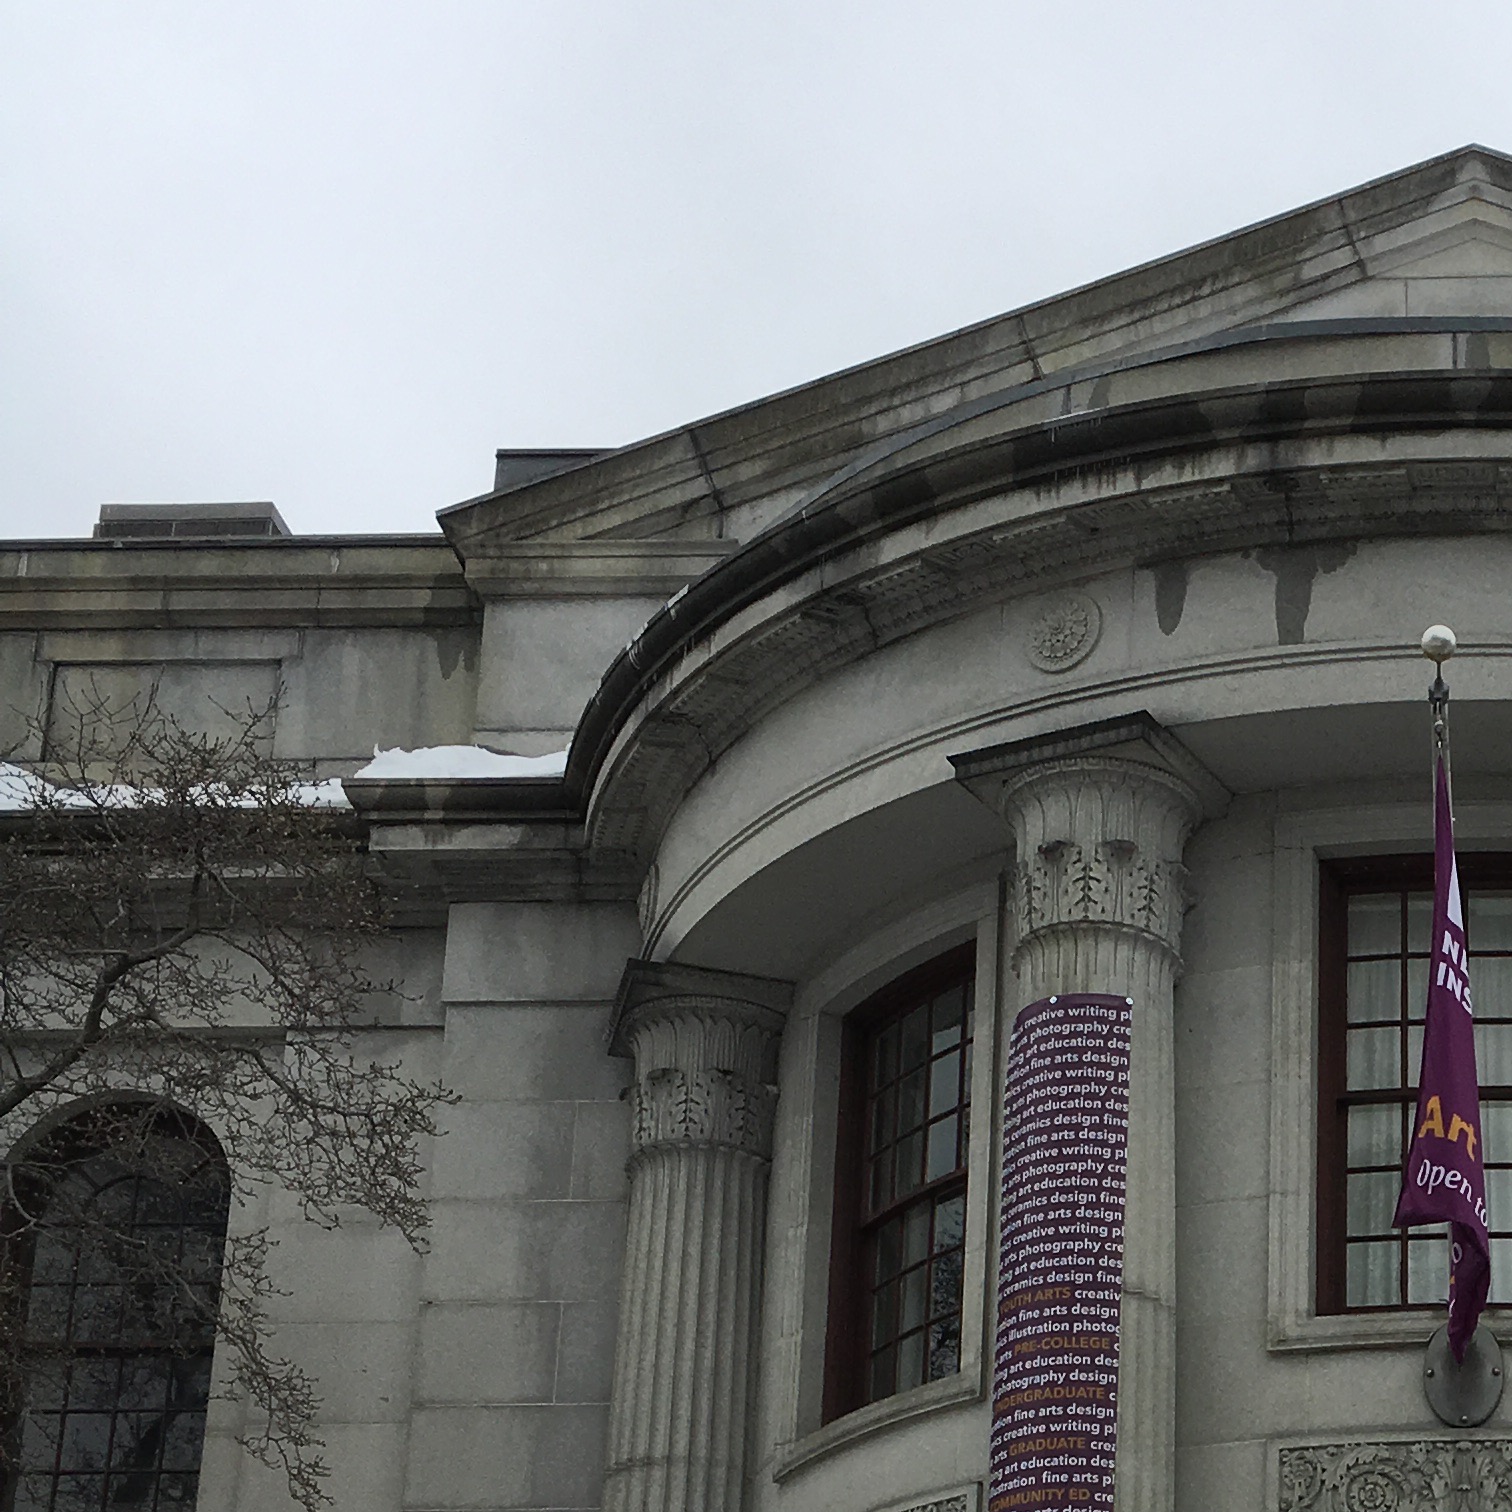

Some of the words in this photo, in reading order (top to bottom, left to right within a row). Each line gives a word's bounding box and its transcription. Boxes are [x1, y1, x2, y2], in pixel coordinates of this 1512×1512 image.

[1024, 1009, 1065, 1029] creative
[1068, 1006, 1116, 1020] writing
[1030, 1021, 1109, 1044] photography
[1040, 1036, 1104, 1051] education
[1031, 1058, 1051, 1069] fine
[1055, 1053, 1078, 1063] arts
[1082, 1051, 1127, 1066] design
[1022, 1070, 1062, 1089] creative
[1066, 1066, 1114, 1081] writing
[1027, 1082, 1107, 1104] photography
[1037, 1097, 1101, 1112] education
[1054, 1113, 1099, 1126] design
[1104, 1114, 1129, 1127] fine
[1027, 1135, 1048, 1146] fine
[1051, 1130, 1075, 1141] arts
[1079, 1128, 1124, 1144] design
[1017, 1148, 1058, 1166] creative
[1062, 1144, 1111, 1158] writing
[1023, 1159, 1104, 1181] photography
[1034, 1176, 1098, 1191] education
[1417, 1159, 1472, 1202] Open
[1051, 1191, 1096, 1204] design
[1100, 1192, 1125, 1205] fine
[1024, 1214, 1044, 1225] fine
[1048, 1208, 1072, 1219] arts
[1076, 1206, 1122, 1222] design
[1013, 1226, 1055, 1245] creative
[1059, 1222, 1108, 1237] writing
[1019, 1238, 1101, 1261] photography
[1030, 1254, 1095, 1270] education
[1047, 1270, 1092, 1284] design
[1035, 1287, 1071, 1301] ARTS
[1019, 1310, 1039, 1322] fine
[1043, 1305, 1067, 1316] arts
[1072, 1303, 1118, 1318] design
[1008, 1321, 1069, 1341] illustration
[1014, 1337, 1110, 1356] PRE-COLLEGE
[1025, 1353, 1090, 1369] education
[1070, 1369, 1116, 1384] design
[1014, 1410, 1035, 1422] fine
[1039, 1405, 1063, 1416] arts
[1067, 1403, 1114, 1418] design
[1003, 1424, 1046, 1441] creative
[1050, 1420, 1100, 1435] writing
[1009, 1437, 1086, 1456] GRADUATE
[1021, 1454, 1086, 1469] education
[1042, 1471, 1068, 1483] fine
[1073, 1472, 1099, 1483] arts
[1069, 1488, 1090, 1500] ED
